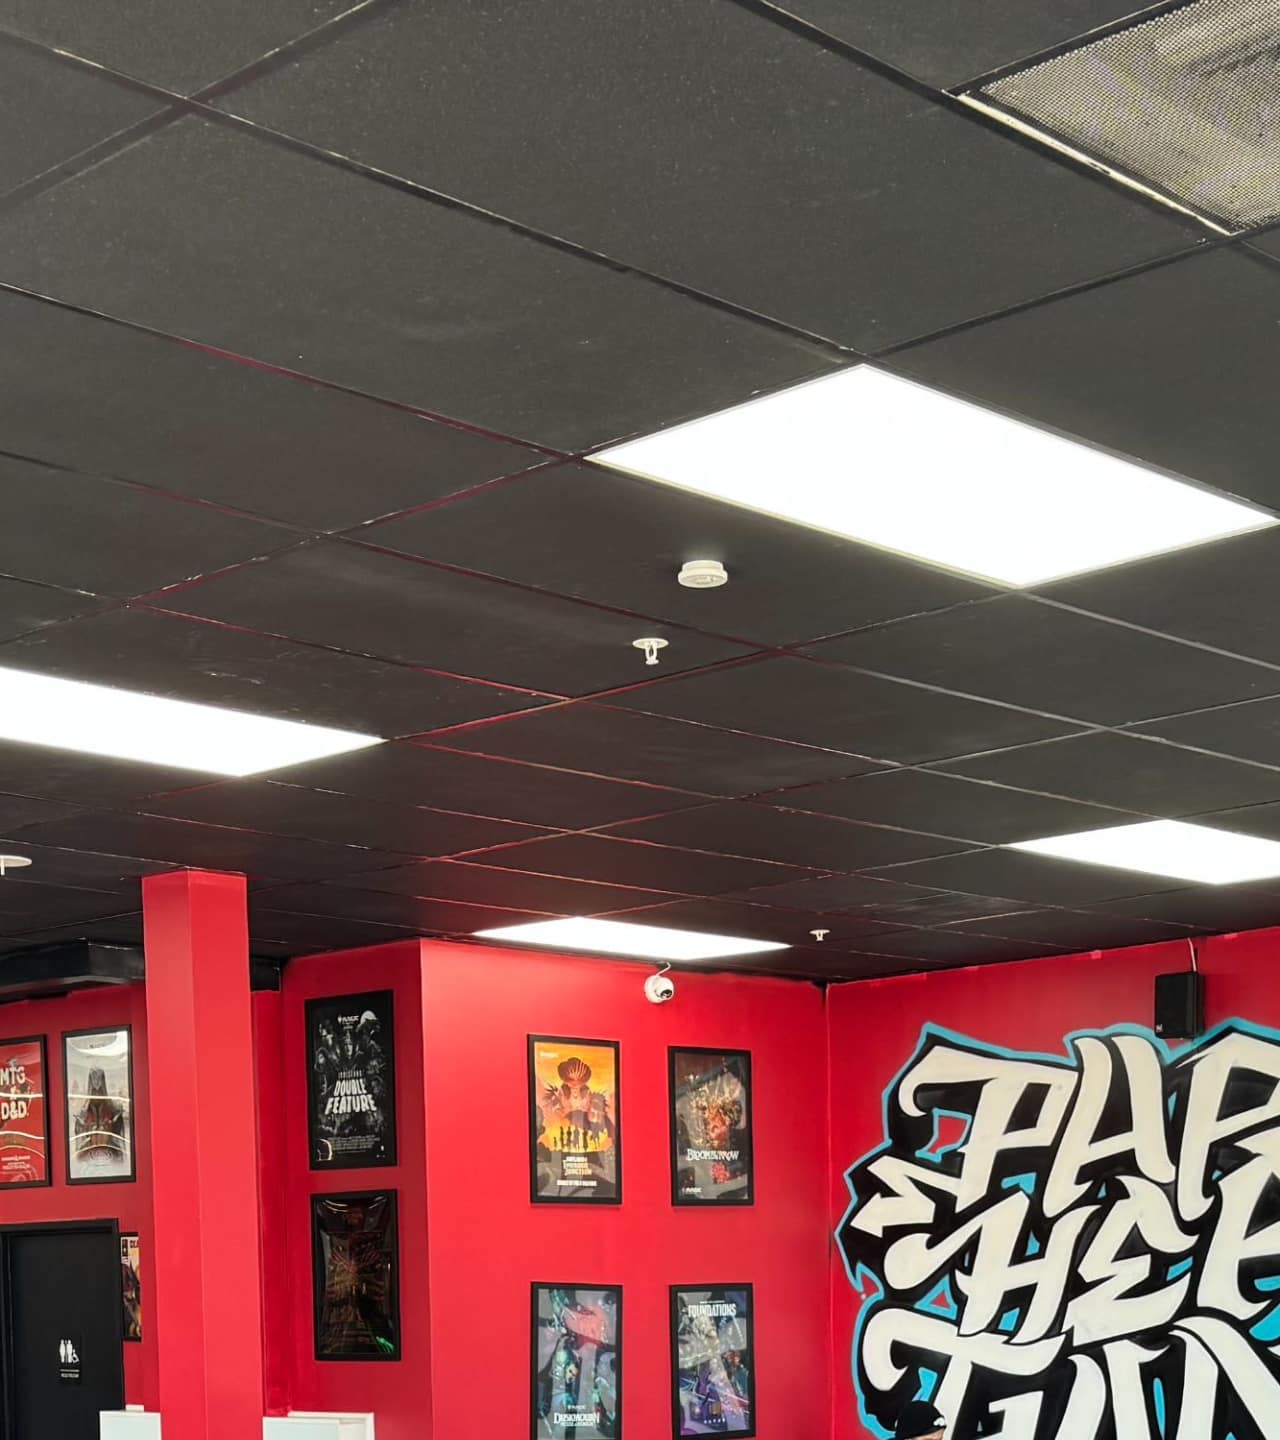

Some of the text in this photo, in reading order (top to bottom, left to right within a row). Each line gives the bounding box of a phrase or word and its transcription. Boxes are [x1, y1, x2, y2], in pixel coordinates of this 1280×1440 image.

[0, 1066, 26, 1086] MTG
[333, 1078, 368, 1097] DOUBLE
[1, 1100, 28, 1120] D&D
[324, 1094, 378, 1115] FEATURE
